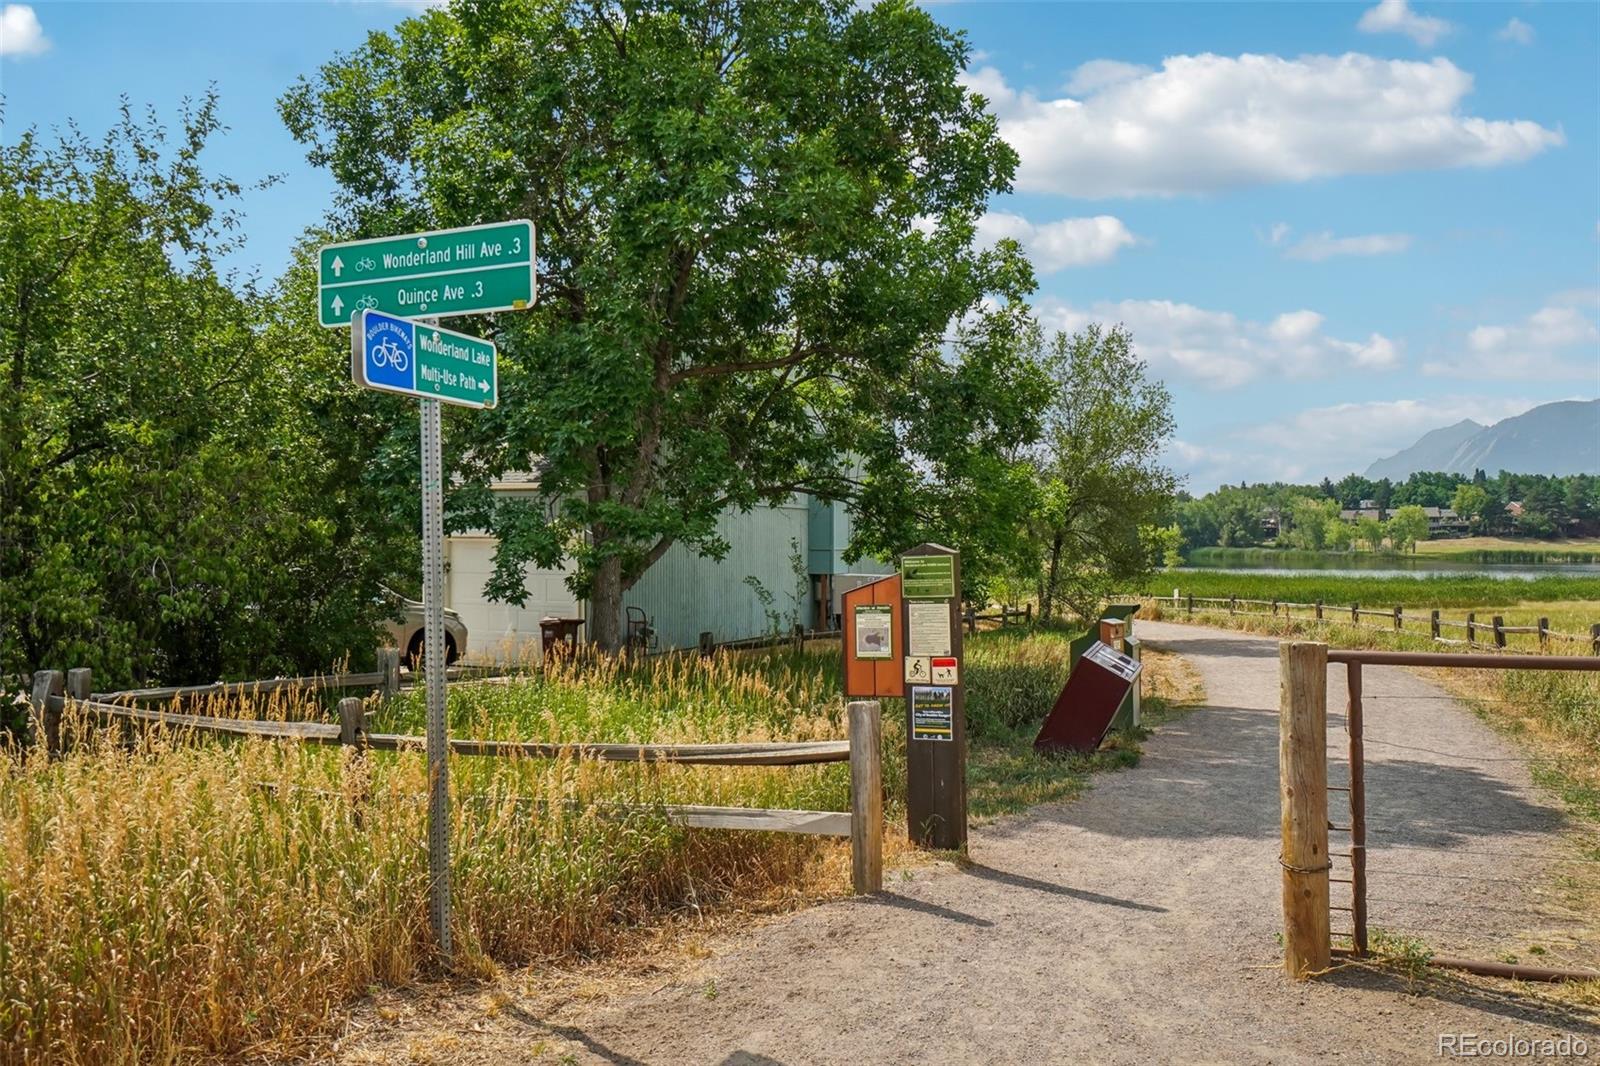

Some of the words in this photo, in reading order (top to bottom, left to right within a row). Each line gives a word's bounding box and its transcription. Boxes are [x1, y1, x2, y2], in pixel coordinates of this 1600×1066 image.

[383, 247, 450, 269] Wonderland
[456, 243, 475, 261] Hill
[480, 241, 502, 257] Ave
[508, 237, 521, 255] .3
[398, 287, 438, 305] Quince
[443, 285, 464, 300] Ave
[471, 281, 484, 298] .3
[420, 334, 469, 361] Wonderland
[471, 347, 491, 367] Lake
[421, 364, 457, 386] Multi-Use
[460, 373, 477, 390] Path
